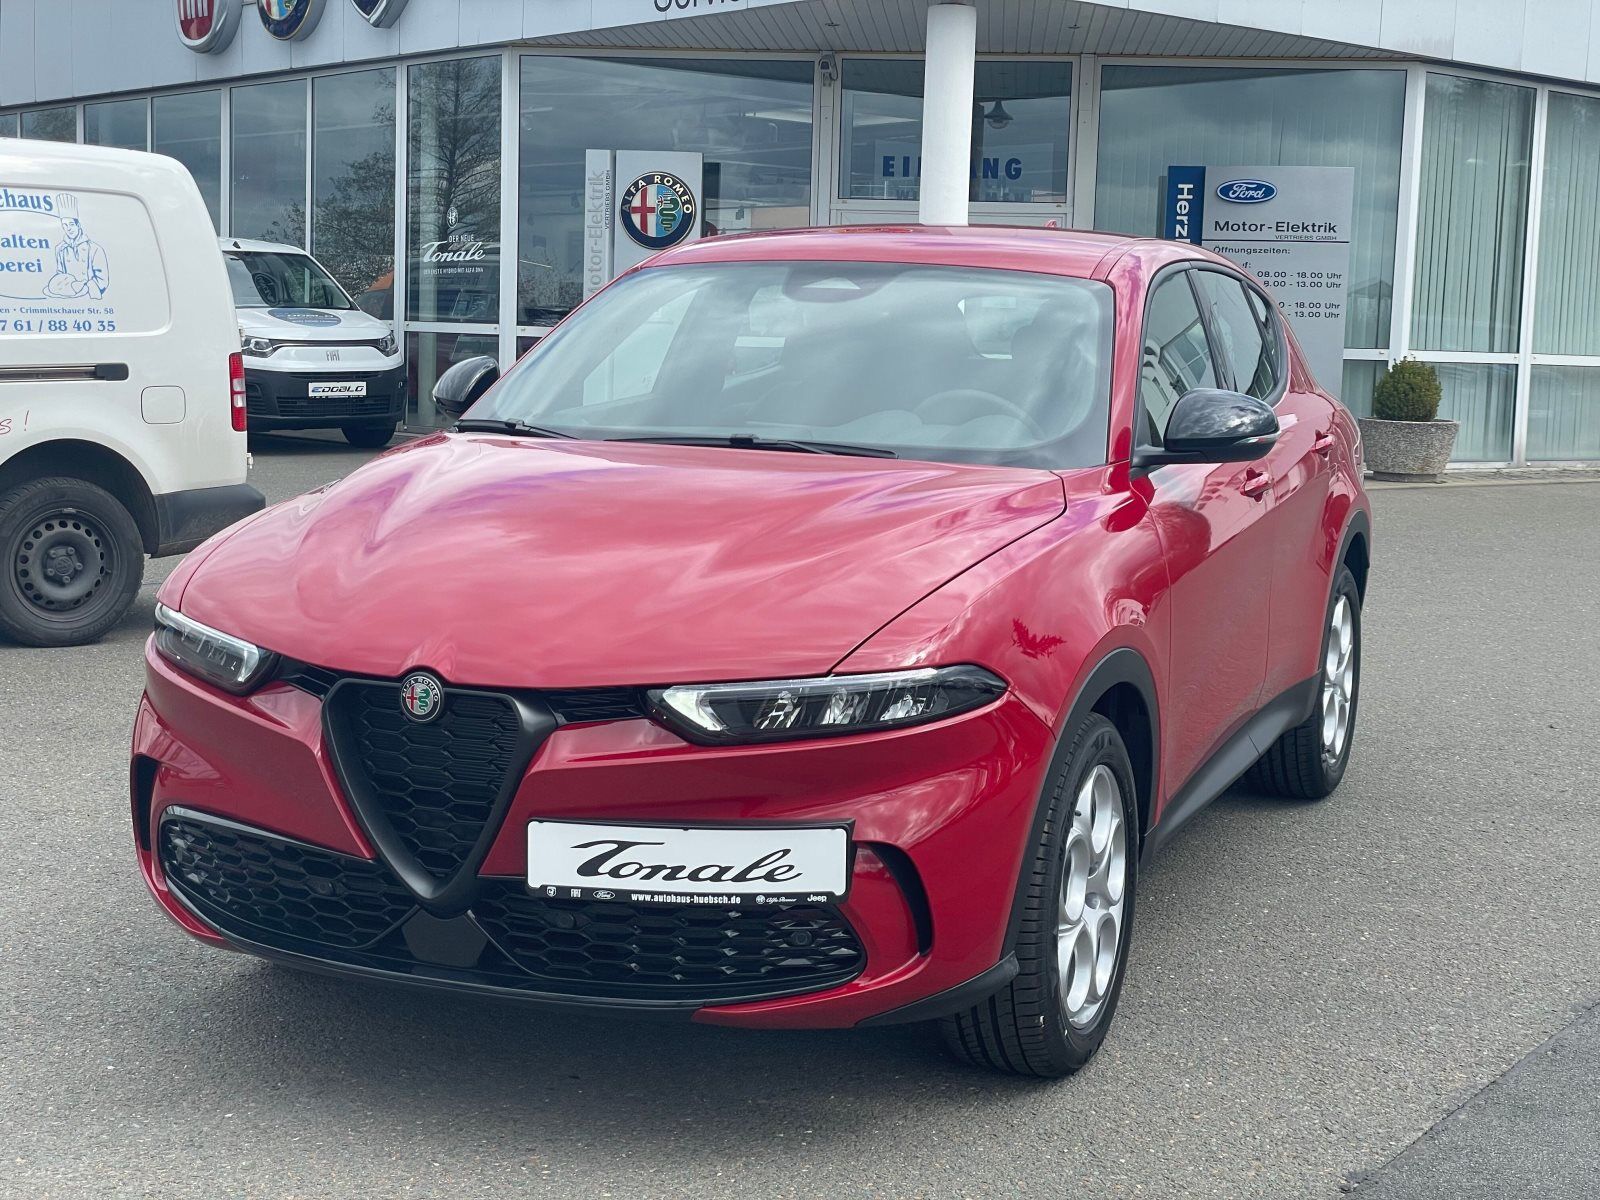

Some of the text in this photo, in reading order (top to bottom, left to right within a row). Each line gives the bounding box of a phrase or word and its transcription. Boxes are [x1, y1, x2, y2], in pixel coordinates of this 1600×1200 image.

[622, 174, 693, 214] ALFA ROMEO
[1228, 183, 1265, 200] Ford
[1214, 220, 1338, 234] Motor-Elektrik
[448, 235, 460, 243] DER
[421, 241, 486, 263] Tonale
[1257, 270, 1287, 279] 08.00
[1296, 271, 1323, 280] 18.00
[1326, 272, 1342, 280] Uhr
[1296, 281, 1323, 289] 13.00
[1326, 281, 1342, 289] Uhr
[19, 306, 85, 314] Crimmitschauer
[87, 307, 102, 315] Str.
[1295, 301, 1322, 310] 18.00
[1324, 302, 1340, 310] Uhr
[1324, 311, 1340, 319] Uhr
[13, 320, 33, 332] 61
[48, 320, 68, 332] 88
[72, 319, 92, 332] 40
[97, 321, 116, 332] 35
[325, 350, 340, 362] FIAT
[402, 678, 439, 701] ALFA ROMEO
[570, 840, 803, 883] Tonale
[631, 893, 741, 904] www.autohaus-huebsch.de
[807, 894, 828, 903] Jeep
